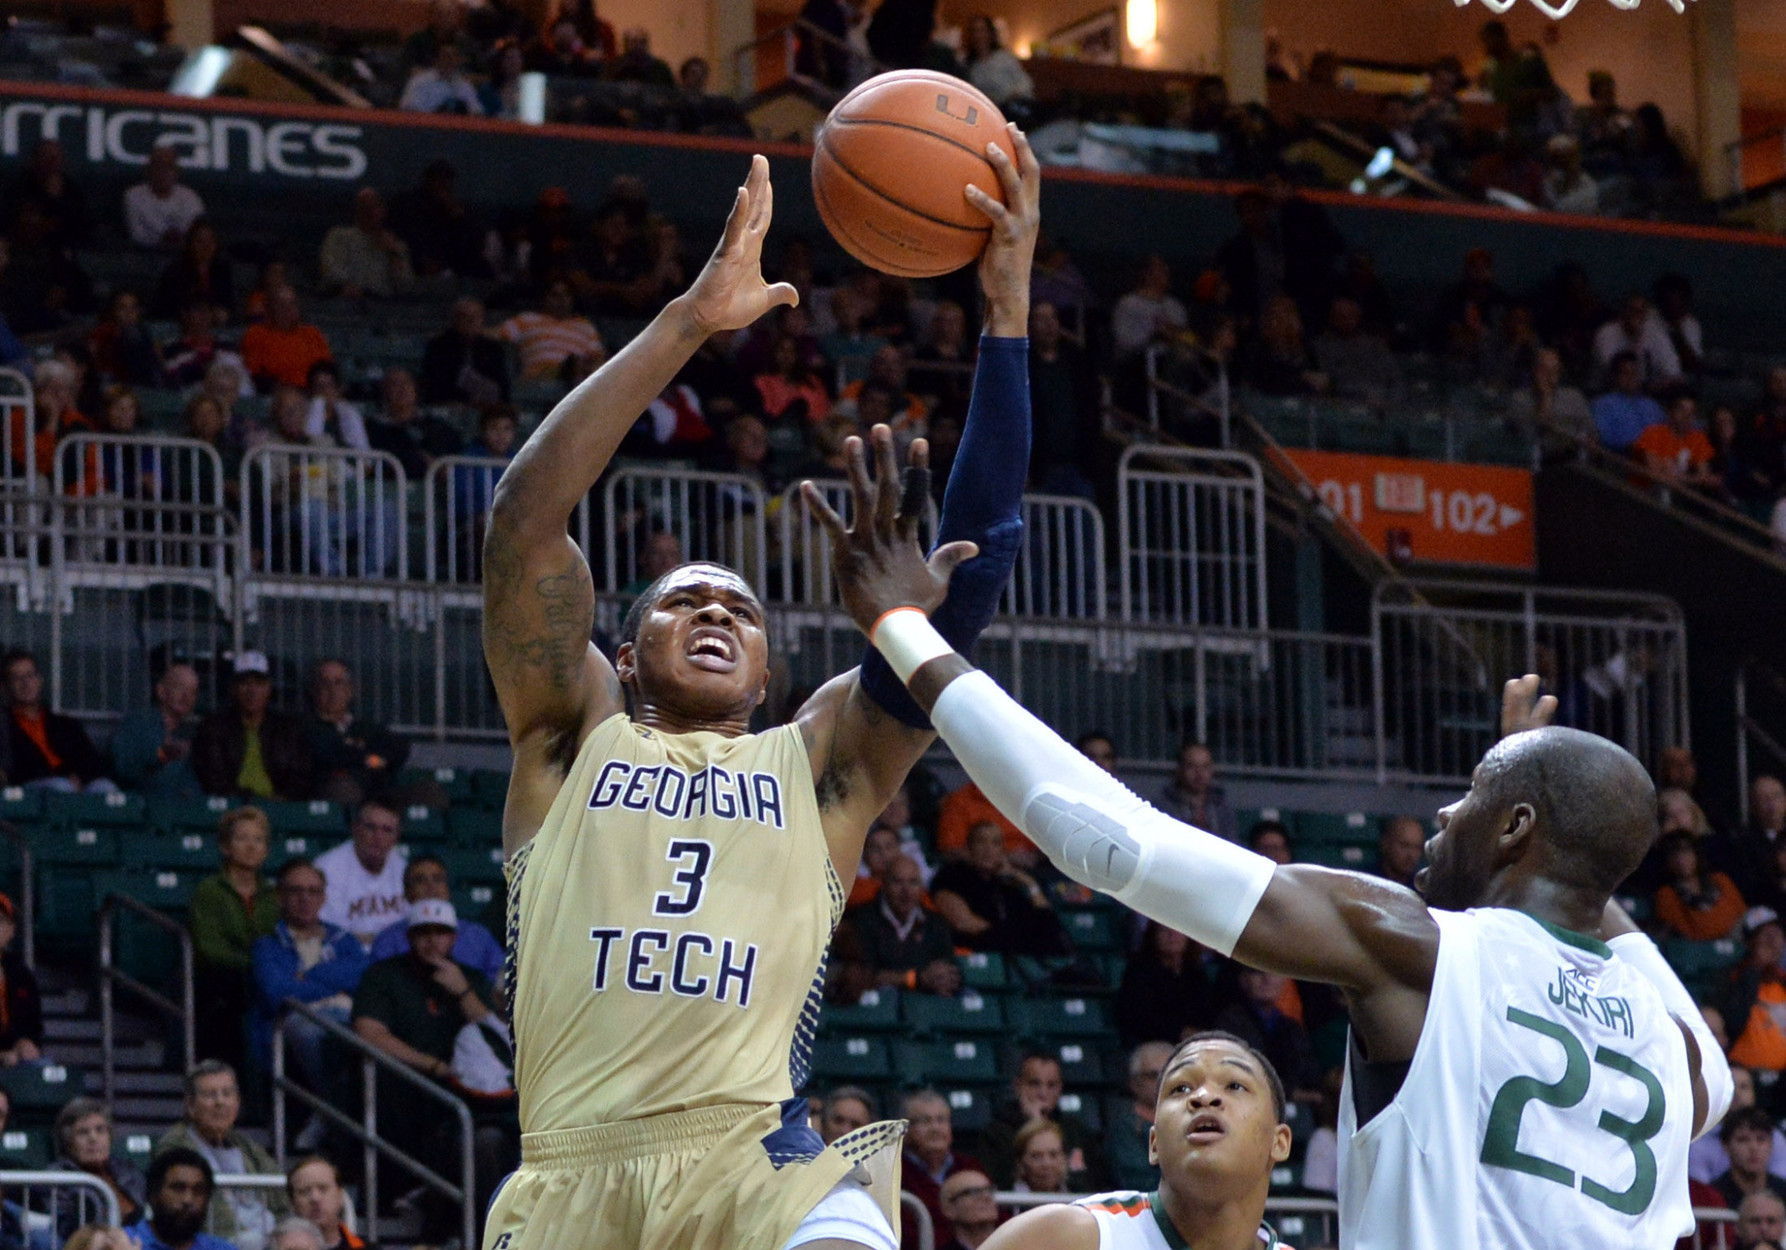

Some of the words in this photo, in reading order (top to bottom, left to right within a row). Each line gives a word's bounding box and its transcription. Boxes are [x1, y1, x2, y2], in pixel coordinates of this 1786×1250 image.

[1430, 488, 1498, 535] 102
[588, 759, 786, 829] GEORGIA
[652, 837, 716, 918] 3
[589, 926, 759, 1010] TECH
[1479, 1004, 1666, 1216] 23
